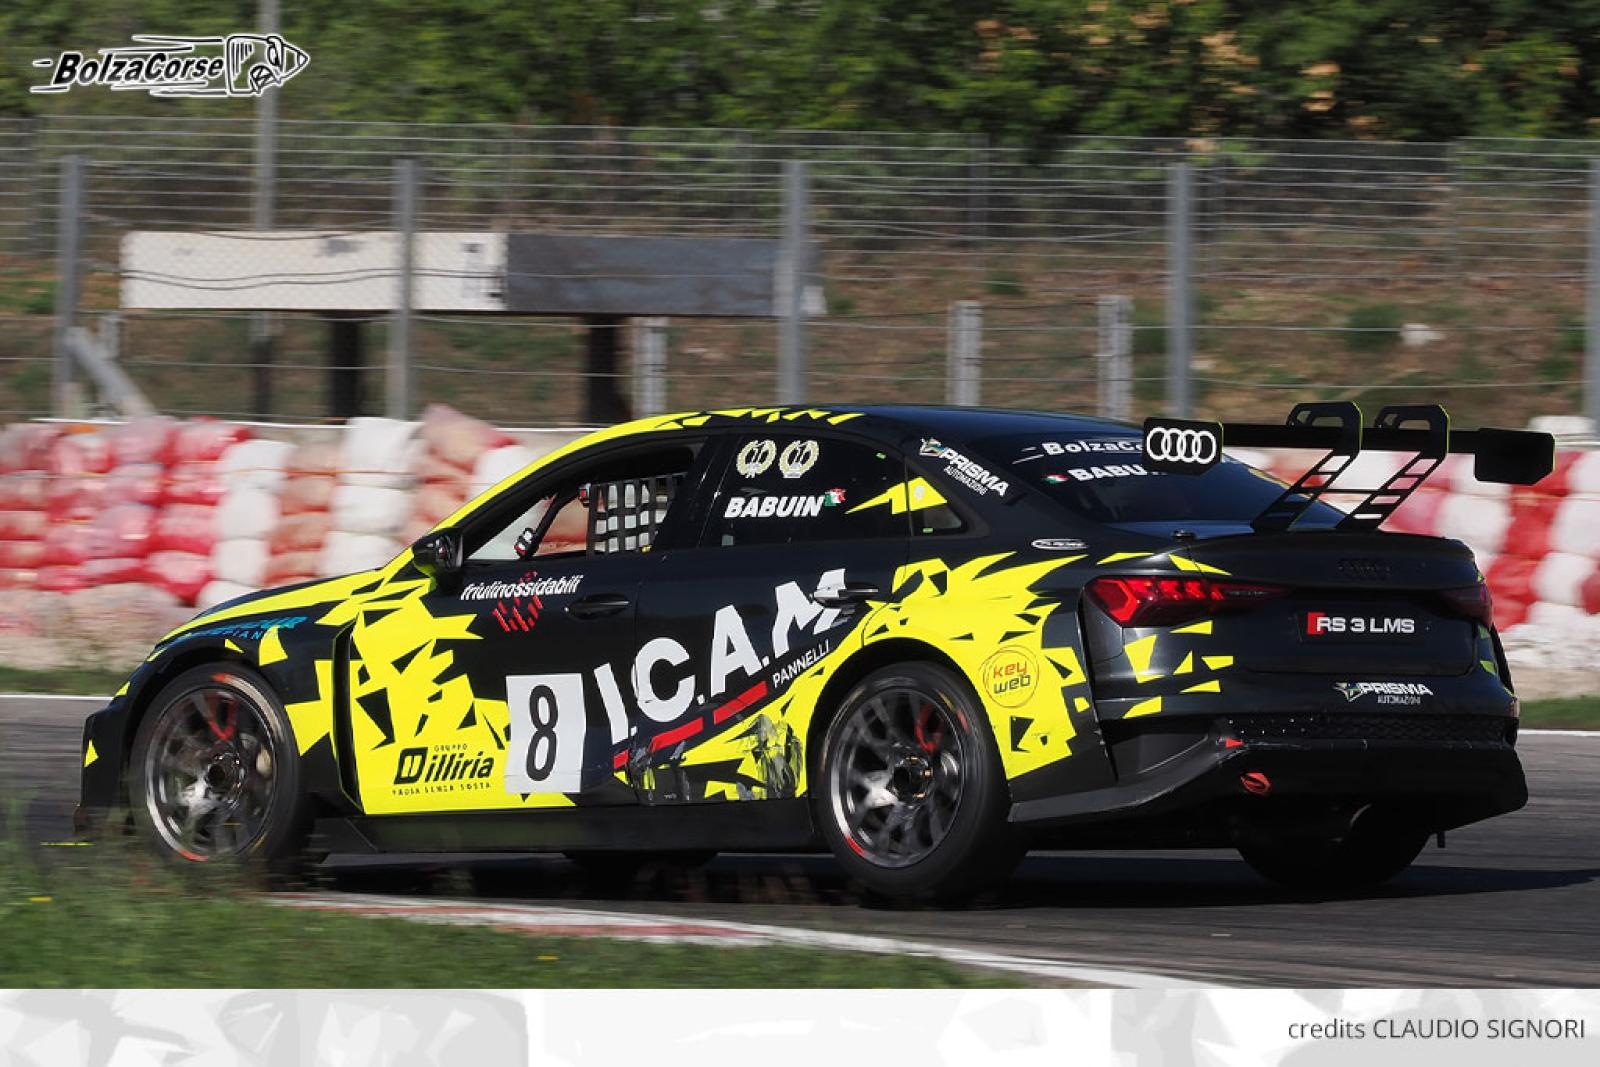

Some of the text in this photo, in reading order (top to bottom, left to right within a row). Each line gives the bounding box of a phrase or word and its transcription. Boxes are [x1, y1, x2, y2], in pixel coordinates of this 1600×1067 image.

[939, 446, 1009, 497] PRISMA
[723, 496, 825, 518] BABUIN
[459, 574, 584, 601] friulinossidabili
[1316, 616, 1415, 634] RS 3 LMS
[772, 638, 831, 688] PANNELLI
[993, 660, 1028, 679] key
[993, 674, 1031, 694] web
[1359, 682, 1434, 696] PRISMA
[525, 683, 559, 782] 8
